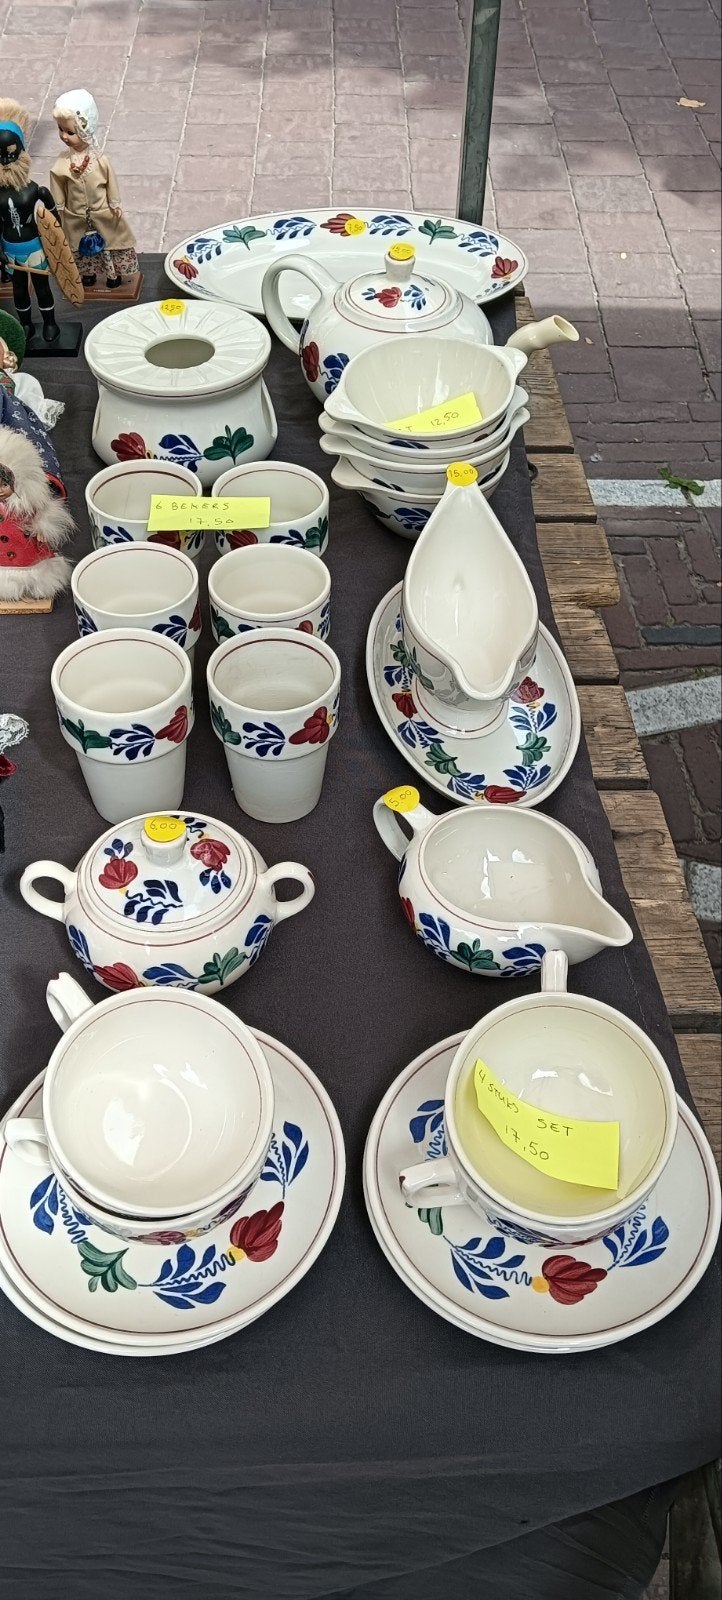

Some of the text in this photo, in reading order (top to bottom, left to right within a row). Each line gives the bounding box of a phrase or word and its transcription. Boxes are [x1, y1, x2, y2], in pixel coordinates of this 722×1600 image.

[430, 411, 460, 427] 12,50
[155, 501, 163, 510] 6
[150, 819, 177, 831] 6.00
[478, 1069, 486, 1083] 4
[536, 1118, 574, 1137] SET
[505, 1124, 550, 1161] 17,50
